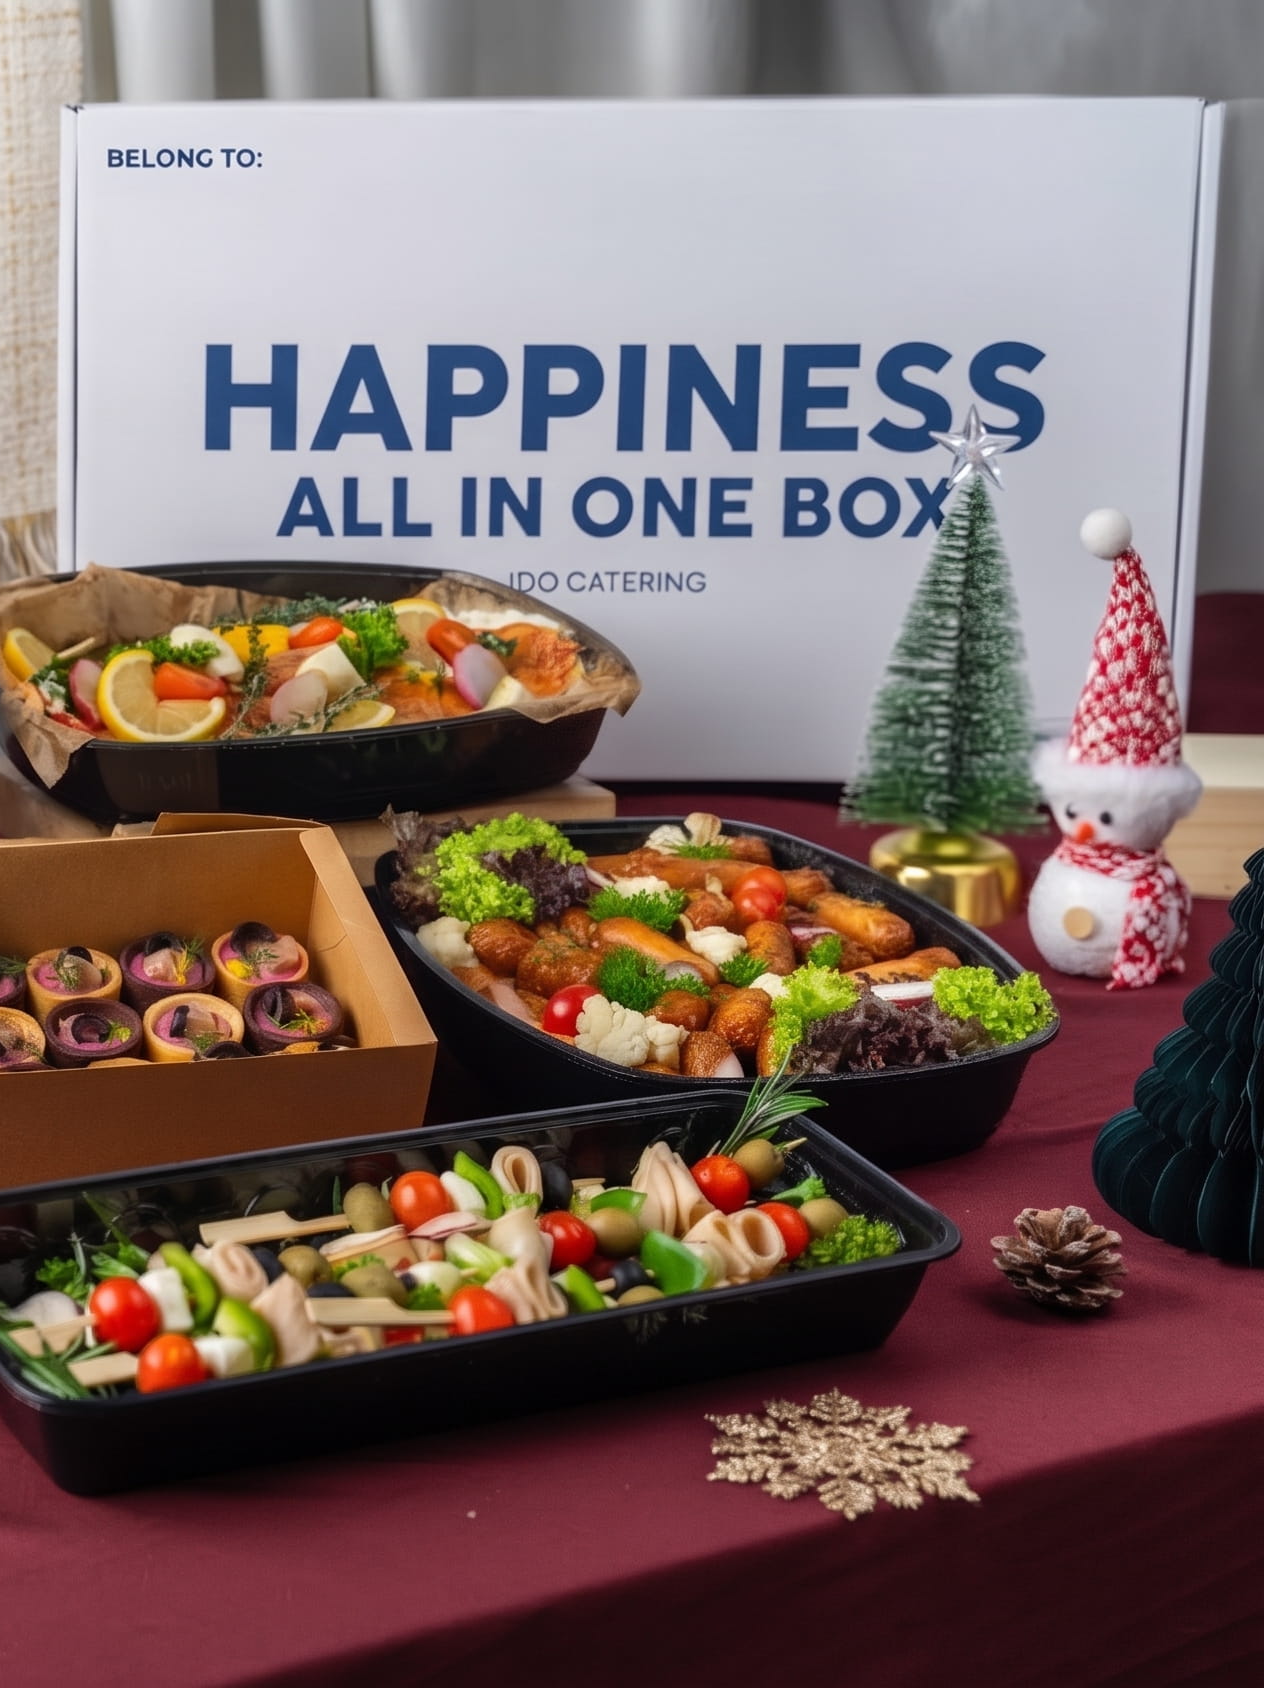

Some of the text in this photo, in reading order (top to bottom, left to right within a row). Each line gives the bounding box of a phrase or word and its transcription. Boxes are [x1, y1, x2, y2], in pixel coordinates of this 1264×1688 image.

[107, 148, 263, 168] BELONG TO:
[203, 341, 1047, 453] HAPPINESS
[277, 475, 953, 540] ALL IN ONE BOX
[509, 571, 707, 593] IDO CATERING
